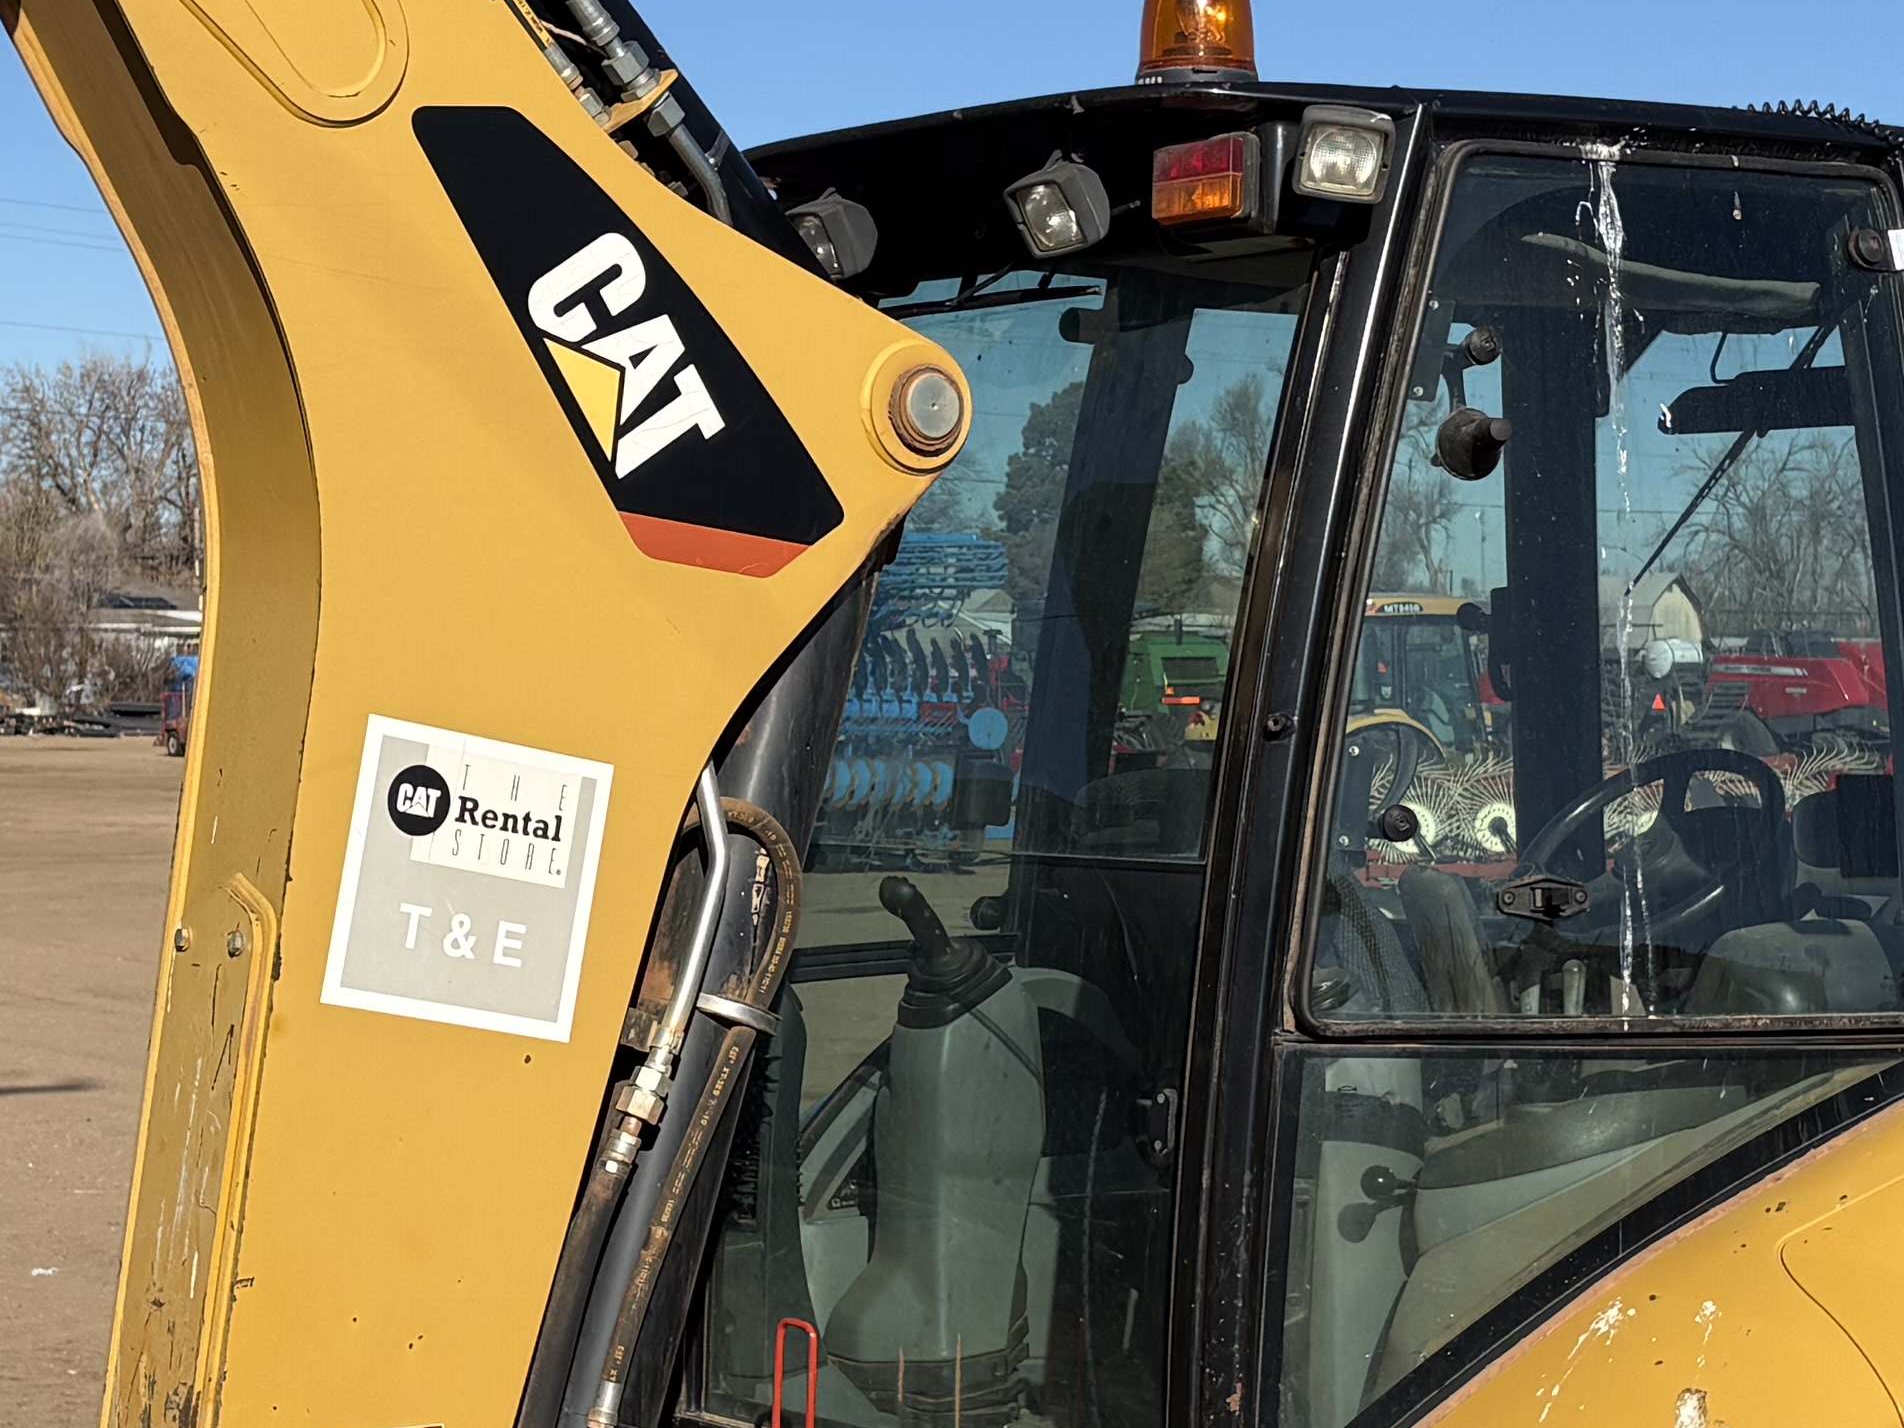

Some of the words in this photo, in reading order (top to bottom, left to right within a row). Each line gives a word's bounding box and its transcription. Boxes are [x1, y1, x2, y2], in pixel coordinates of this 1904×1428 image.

[528, 232, 725, 479] CAT
[396, 783, 442, 818] CAT
[455, 795, 563, 842] Rental
